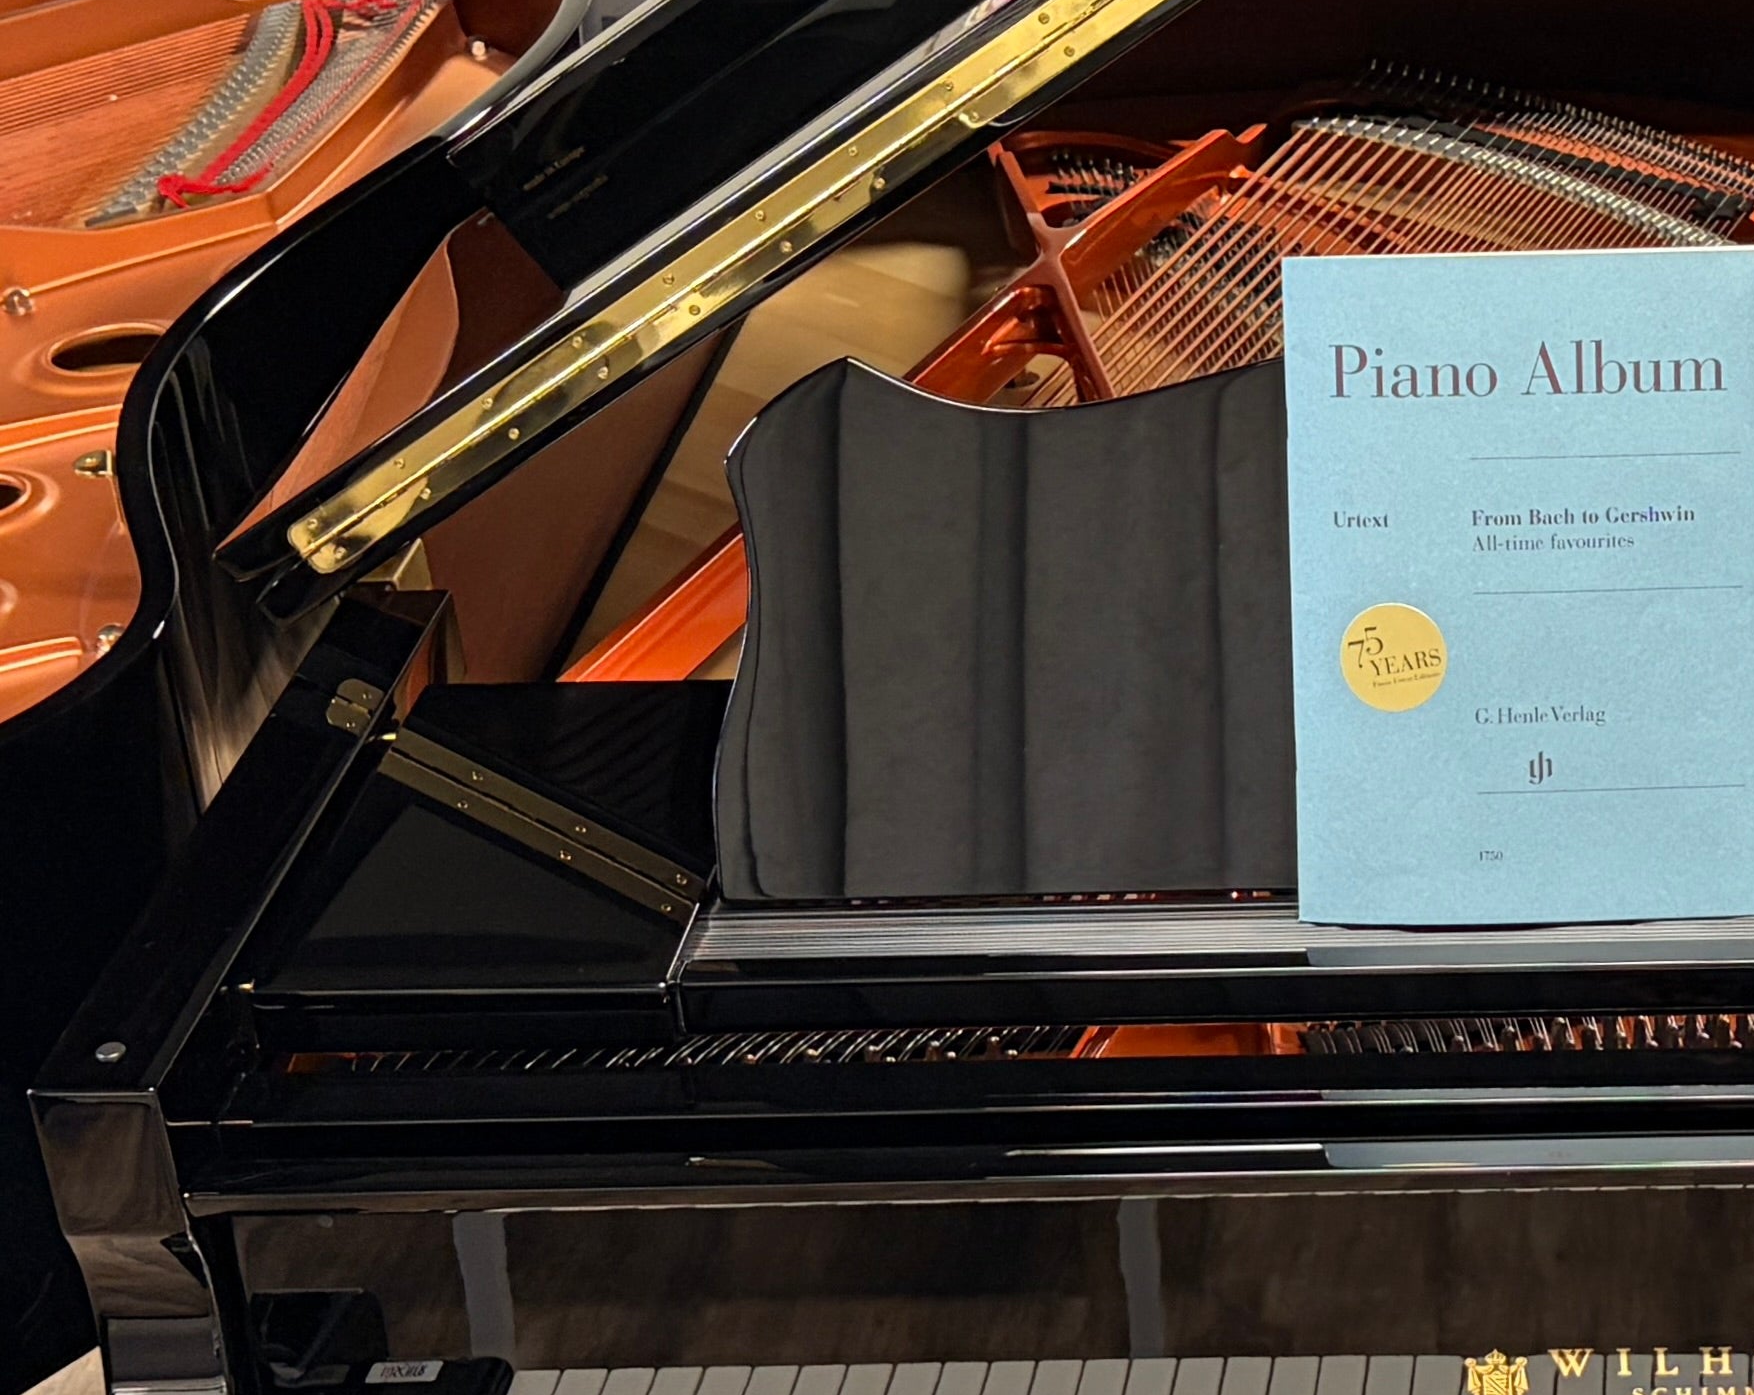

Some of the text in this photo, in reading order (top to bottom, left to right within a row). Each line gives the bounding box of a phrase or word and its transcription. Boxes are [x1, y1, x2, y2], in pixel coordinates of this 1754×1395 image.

[1329, 339, 1728, 399] Piano Album
[1333, 510, 1389, 529] Urtext
[1471, 506, 1695, 527] From Bach to Gershwin
[1471, 533, 1635, 553] All-time favourites
[1347, 626, 1384, 669] 75
[1370, 648, 1442, 677] YEARS
[1475, 705, 1607, 727] G. Henle Verlag
